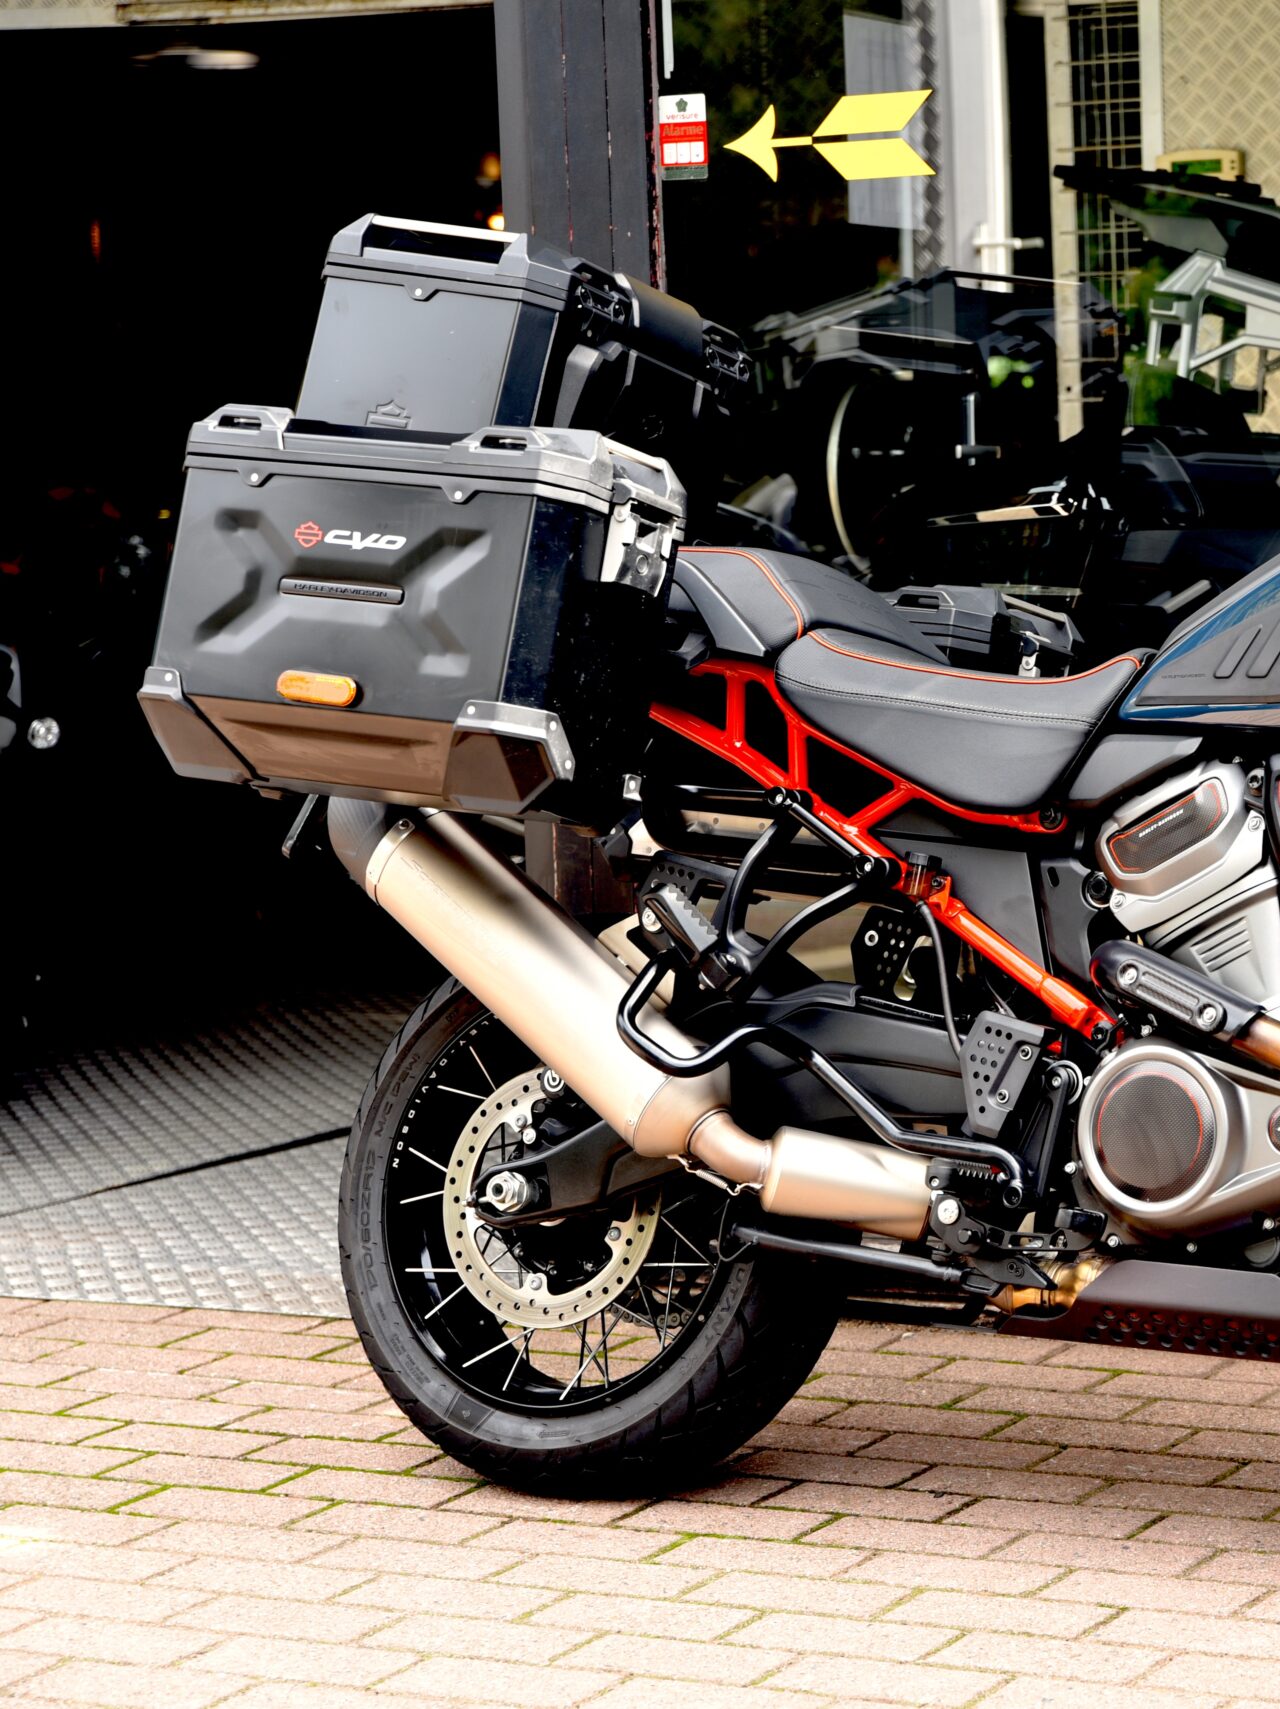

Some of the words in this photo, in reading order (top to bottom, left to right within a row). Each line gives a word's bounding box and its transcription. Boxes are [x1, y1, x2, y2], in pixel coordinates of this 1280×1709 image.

[662, 124, 704, 136] Alarme
[324, 529, 407, 550] CVO
[294, 583, 388, 597] HARLEY-DAVIDSON
[391, 1016, 499, 1169] LEY-DAVIDSON
